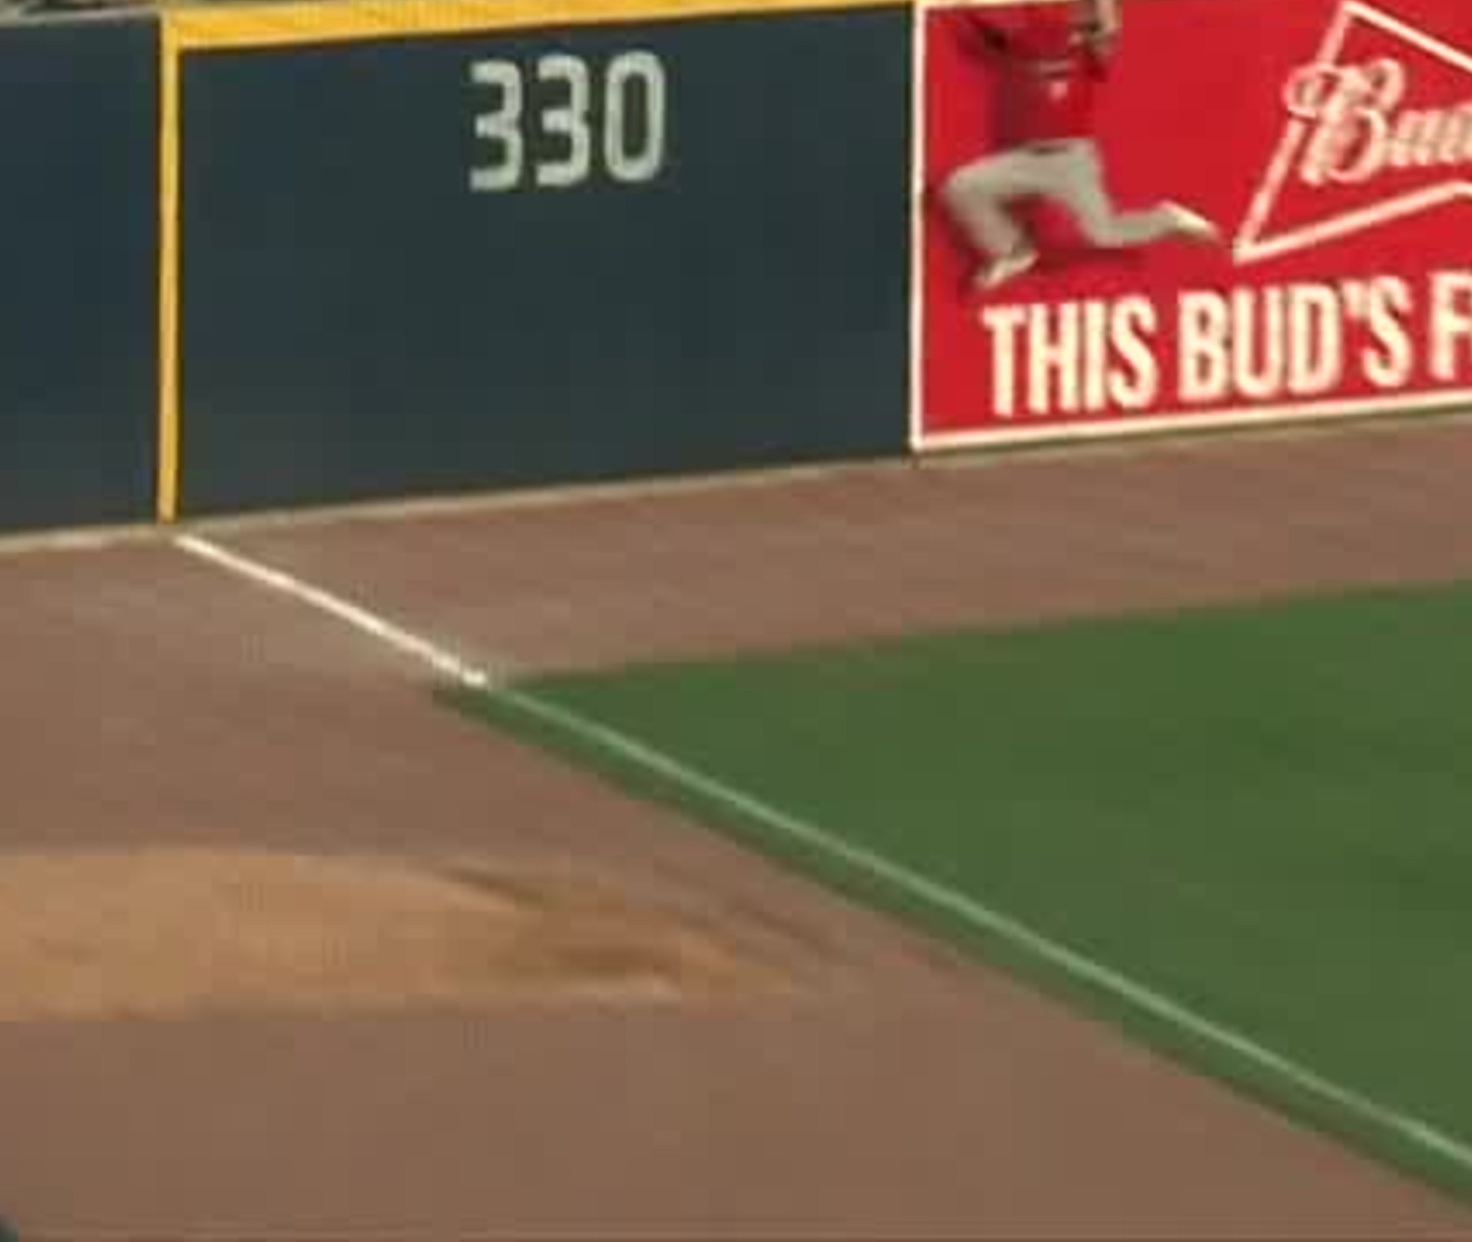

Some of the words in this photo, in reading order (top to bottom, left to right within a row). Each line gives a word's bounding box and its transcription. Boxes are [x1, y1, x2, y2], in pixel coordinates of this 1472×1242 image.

[470, 51, 665, 192] 330
[982, 294, 1159, 419] THIS
[1179, 275, 1413, 402] BUD'S
